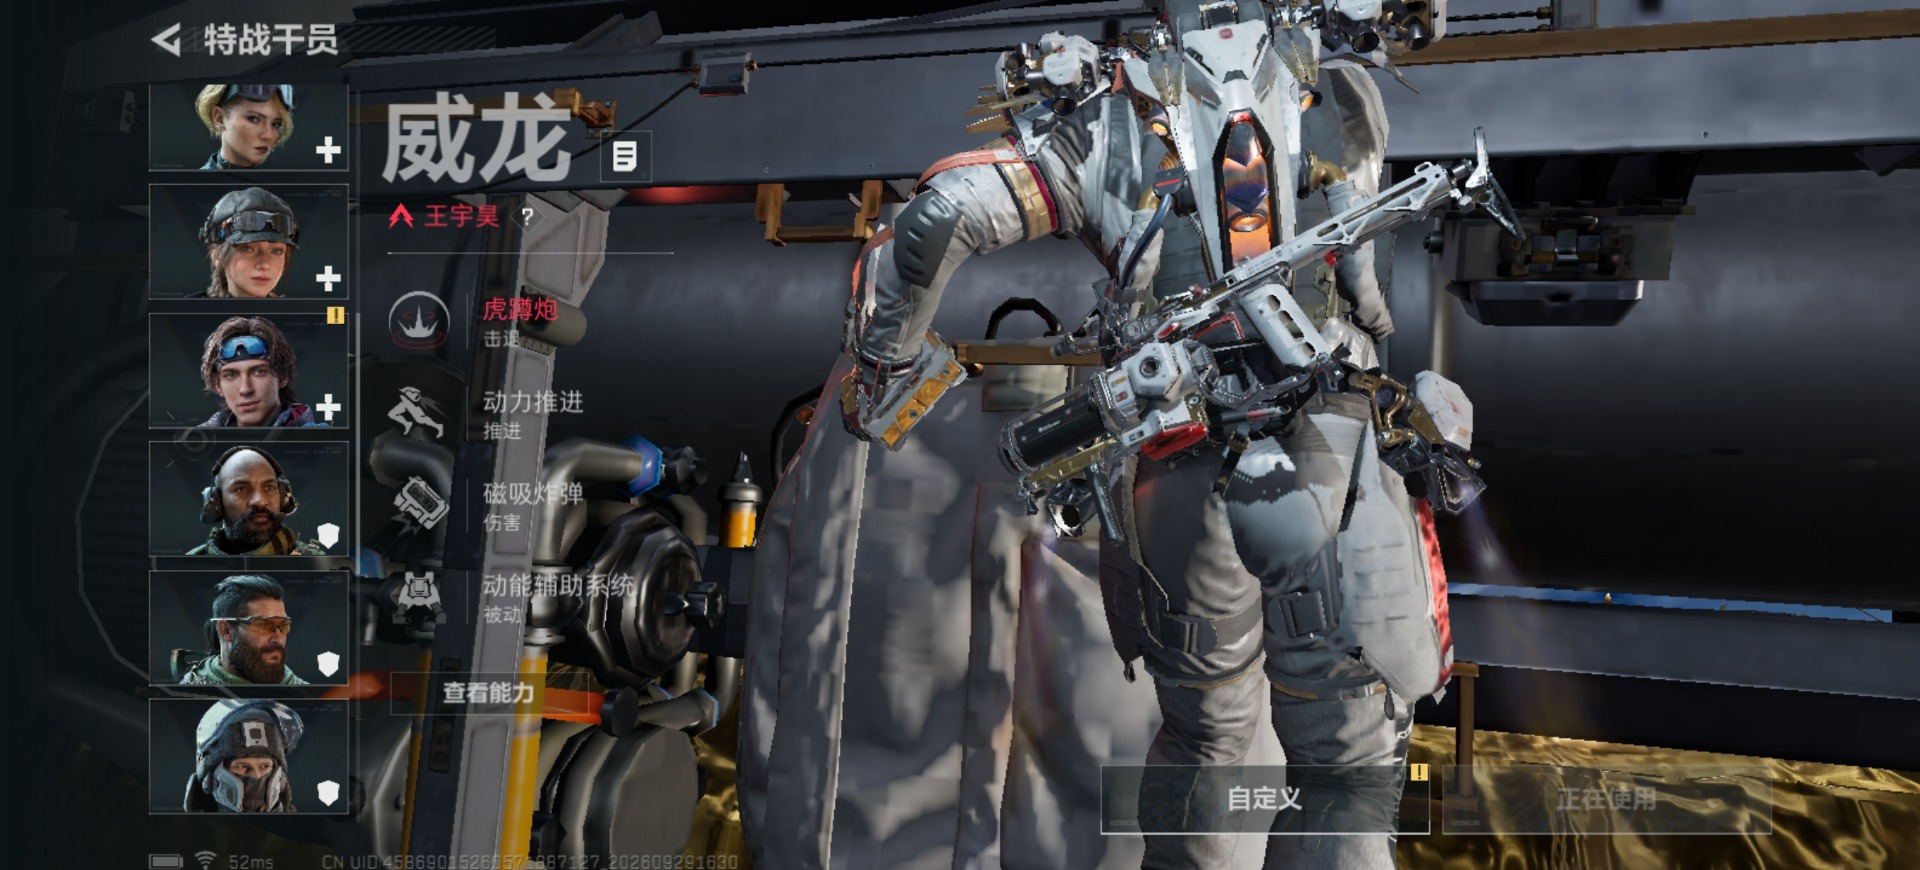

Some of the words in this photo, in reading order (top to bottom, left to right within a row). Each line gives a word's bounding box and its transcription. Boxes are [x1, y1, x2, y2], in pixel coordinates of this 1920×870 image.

[204, 22, 338, 56] 特战干员
[382, 91, 571, 184] 威龙
[424, 204, 499, 228] 王宇昊
[483, 297, 559, 321] 虎蹲炮
[483, 330, 520, 348] 击退
[483, 390, 584, 414] 动力推进
[483, 422, 522, 441] 推进
[483, 482, 584, 506] 磁吸炸弹
[483, 513, 521, 532] 伤害
[483, 573, 635, 598] 动能辅助系统
[483, 606, 522, 624] 被动
[443, 681, 535, 704] 查看能力
[1228, 785, 1303, 812] 自定义
[1556, 786, 1657, 812] 正在使用
[229, 854, 274, 870] 52ms
[321, 854, 344, 870] CN
